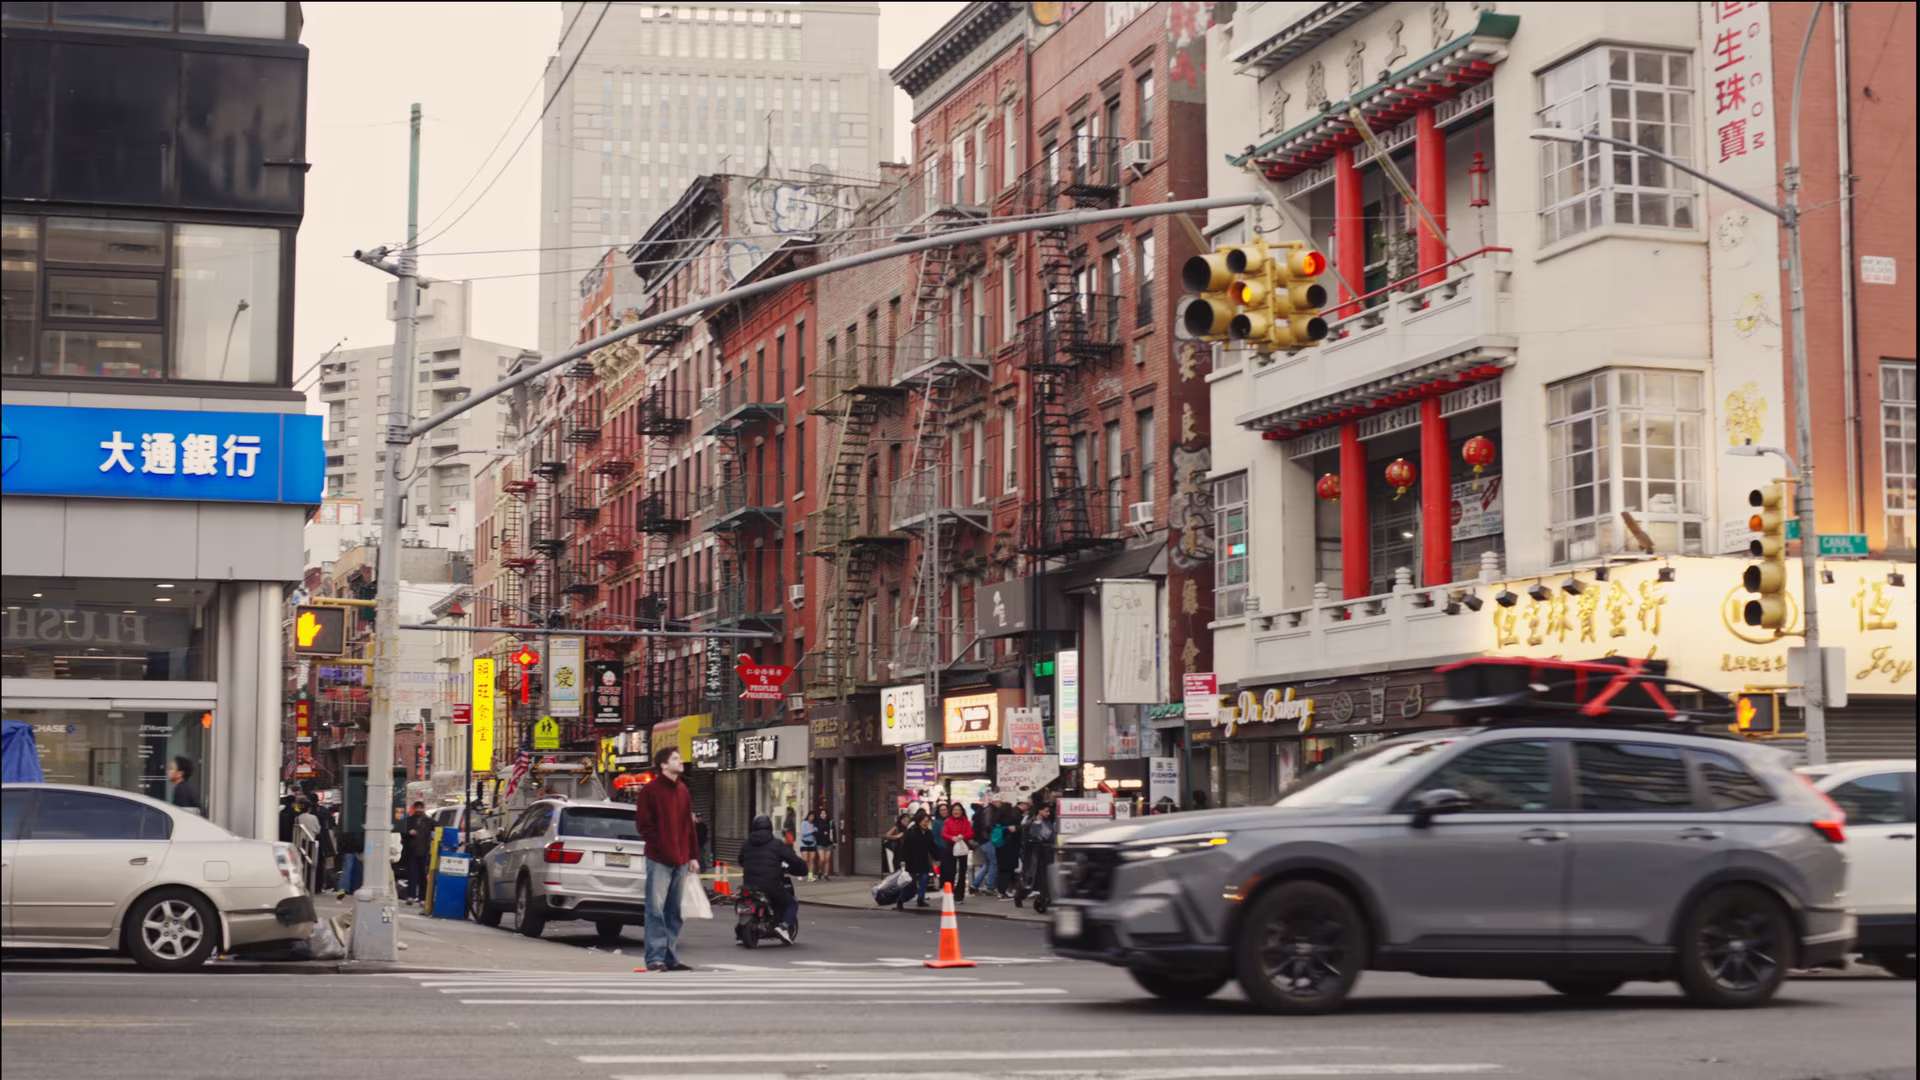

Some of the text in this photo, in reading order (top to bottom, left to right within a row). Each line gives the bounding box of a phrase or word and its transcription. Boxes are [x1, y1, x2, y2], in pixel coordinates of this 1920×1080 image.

[99, 430, 261, 477] 大通銀行
[1822, 537, 1850, 548] CANAL
[1856, 646, 1913, 683] Joy
[749, 684, 779, 692] PEOPLES
[1262, 687, 1316, 732] Bakery
